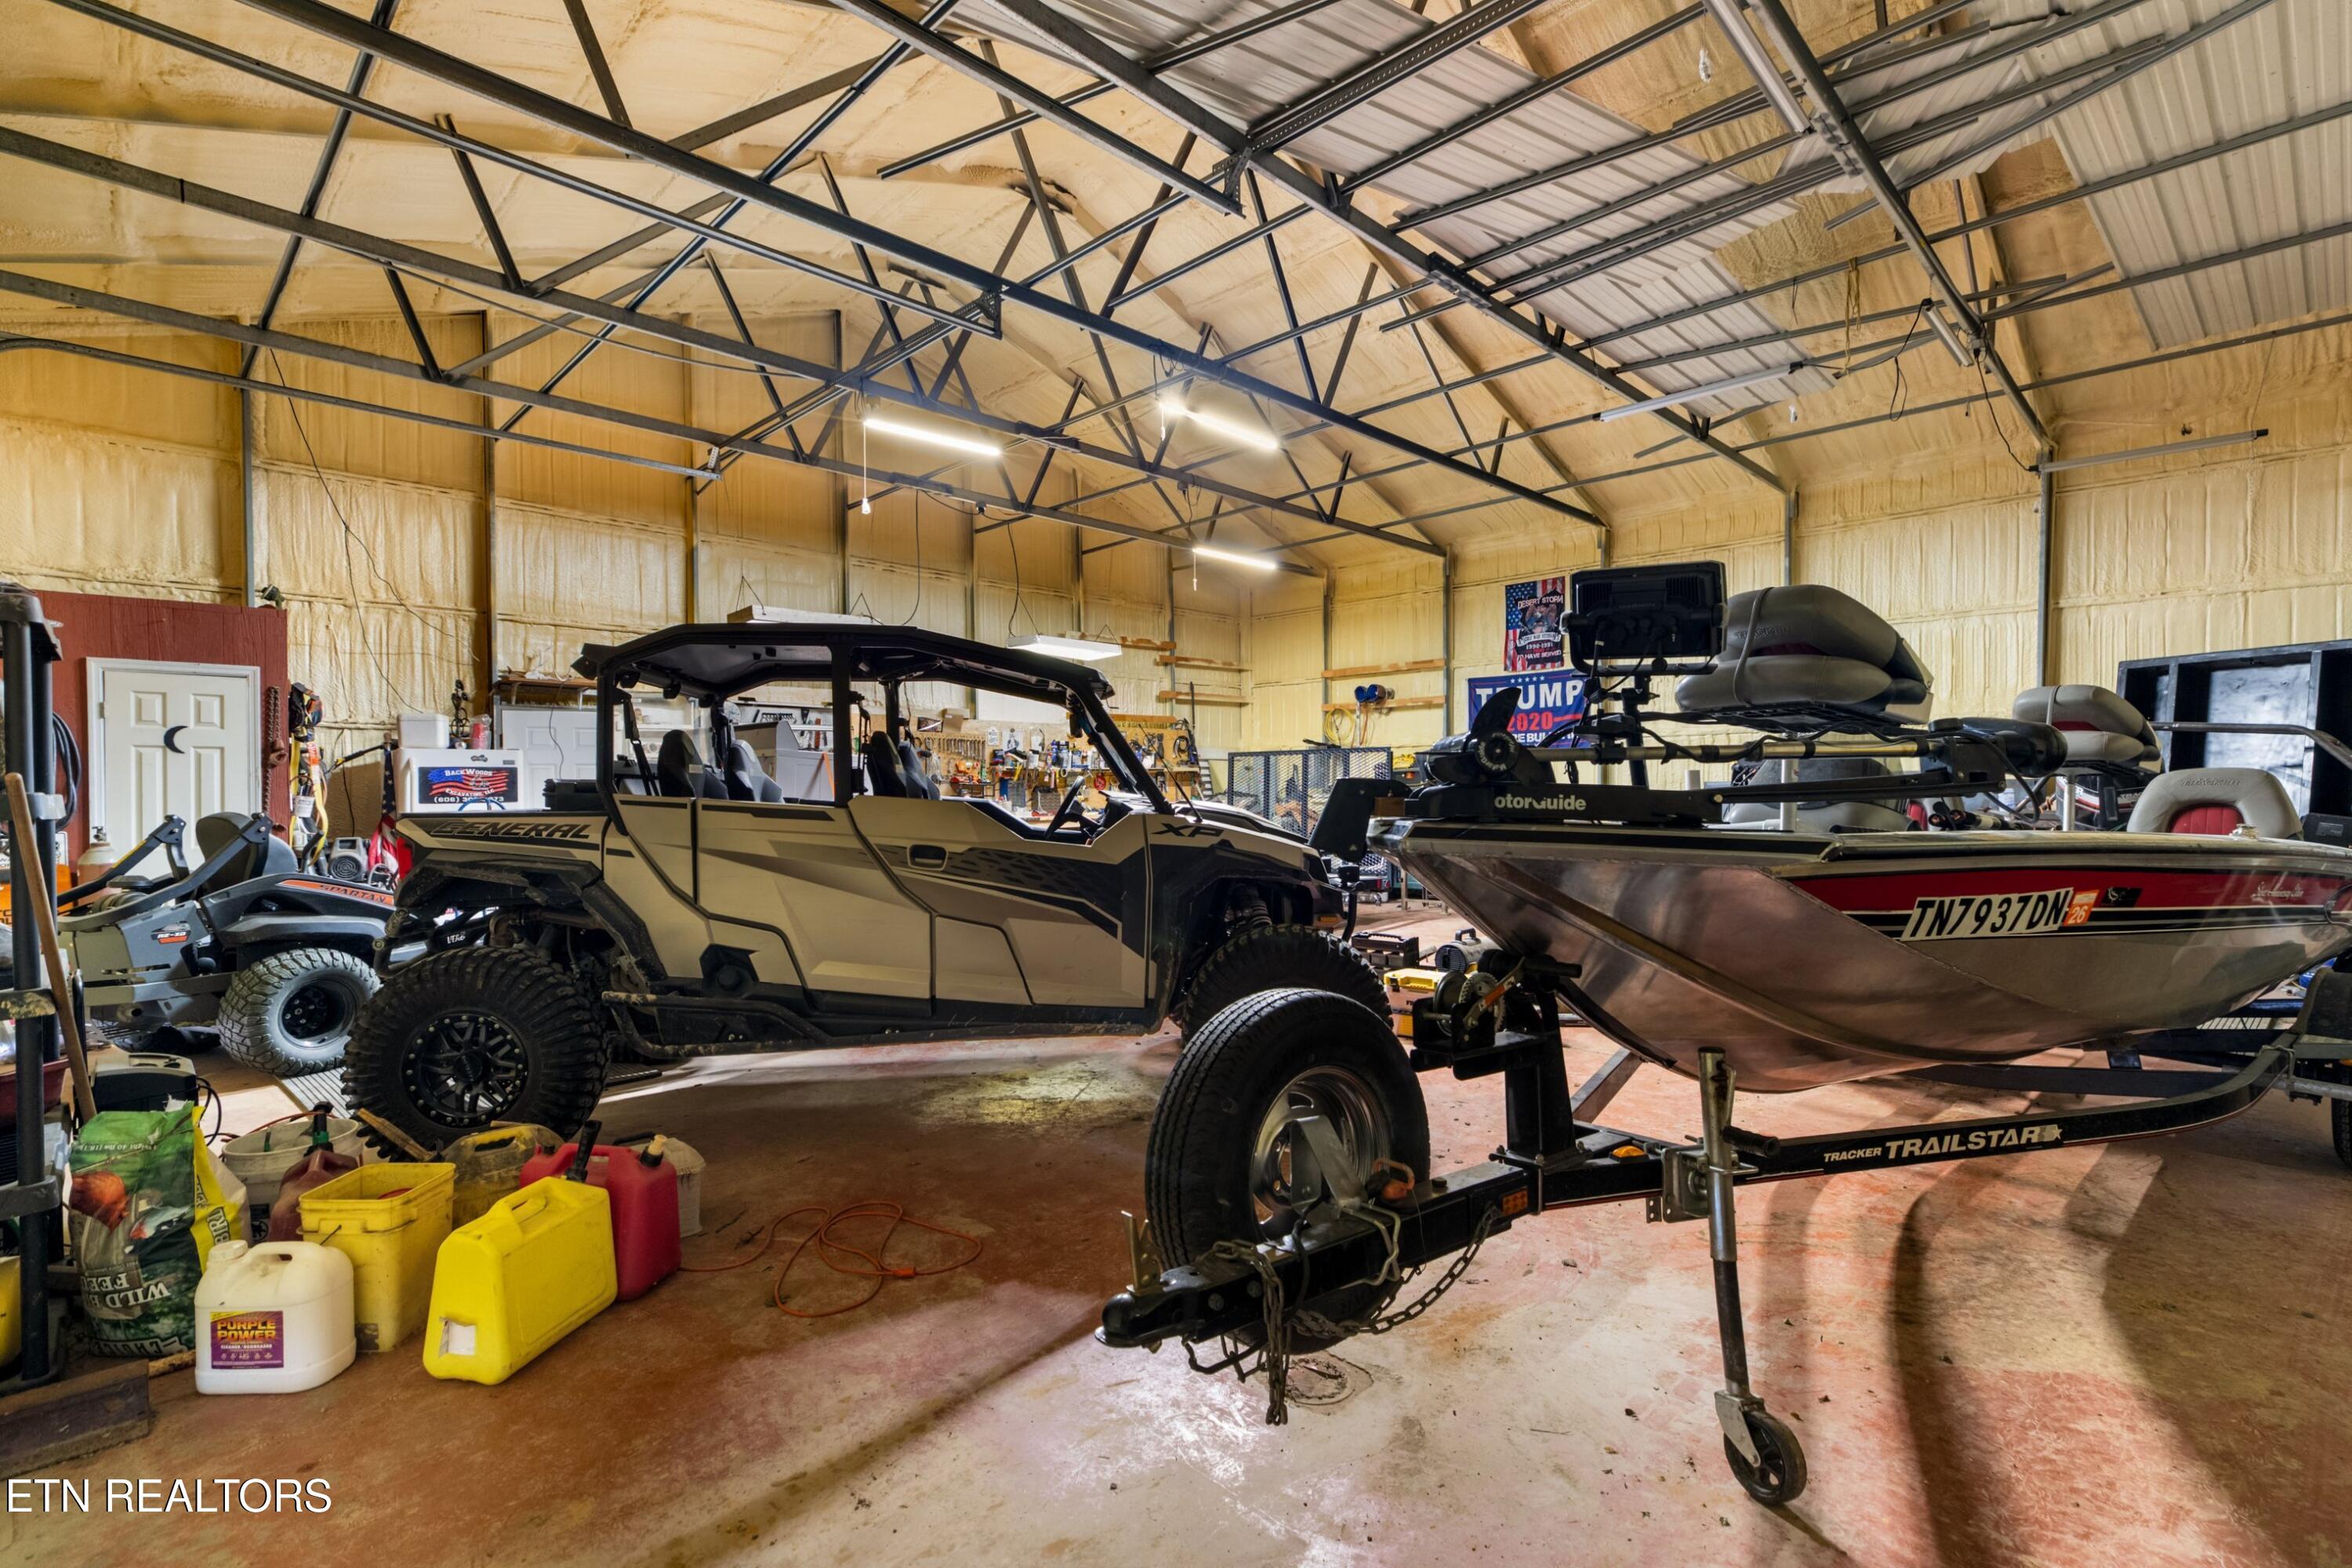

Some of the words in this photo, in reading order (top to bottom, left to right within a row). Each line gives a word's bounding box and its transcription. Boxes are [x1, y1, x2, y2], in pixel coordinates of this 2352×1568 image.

[1517, 598, 1541, 609] DESERT
[1541, 595, 1563, 604] STORM
[1475, 680, 1584, 710] TUMP
[1494, 793, 1587, 811] otorGuide
[430, 822, 591, 839] GENERAL
[1150, 822, 1225, 837] XP
[318, 884, 387, 904] SPARTAN
[2067, 905, 2089, 925] 26
[1824, 1147, 1882, 1163] TRACKER
[1885, 1125, 2041, 1160] TRAILSTAR
[105, 1281, 172, 1309] WILD
[217, 1319, 277, 1330] PURPLE
[217, 1330, 277, 1341] POWER
